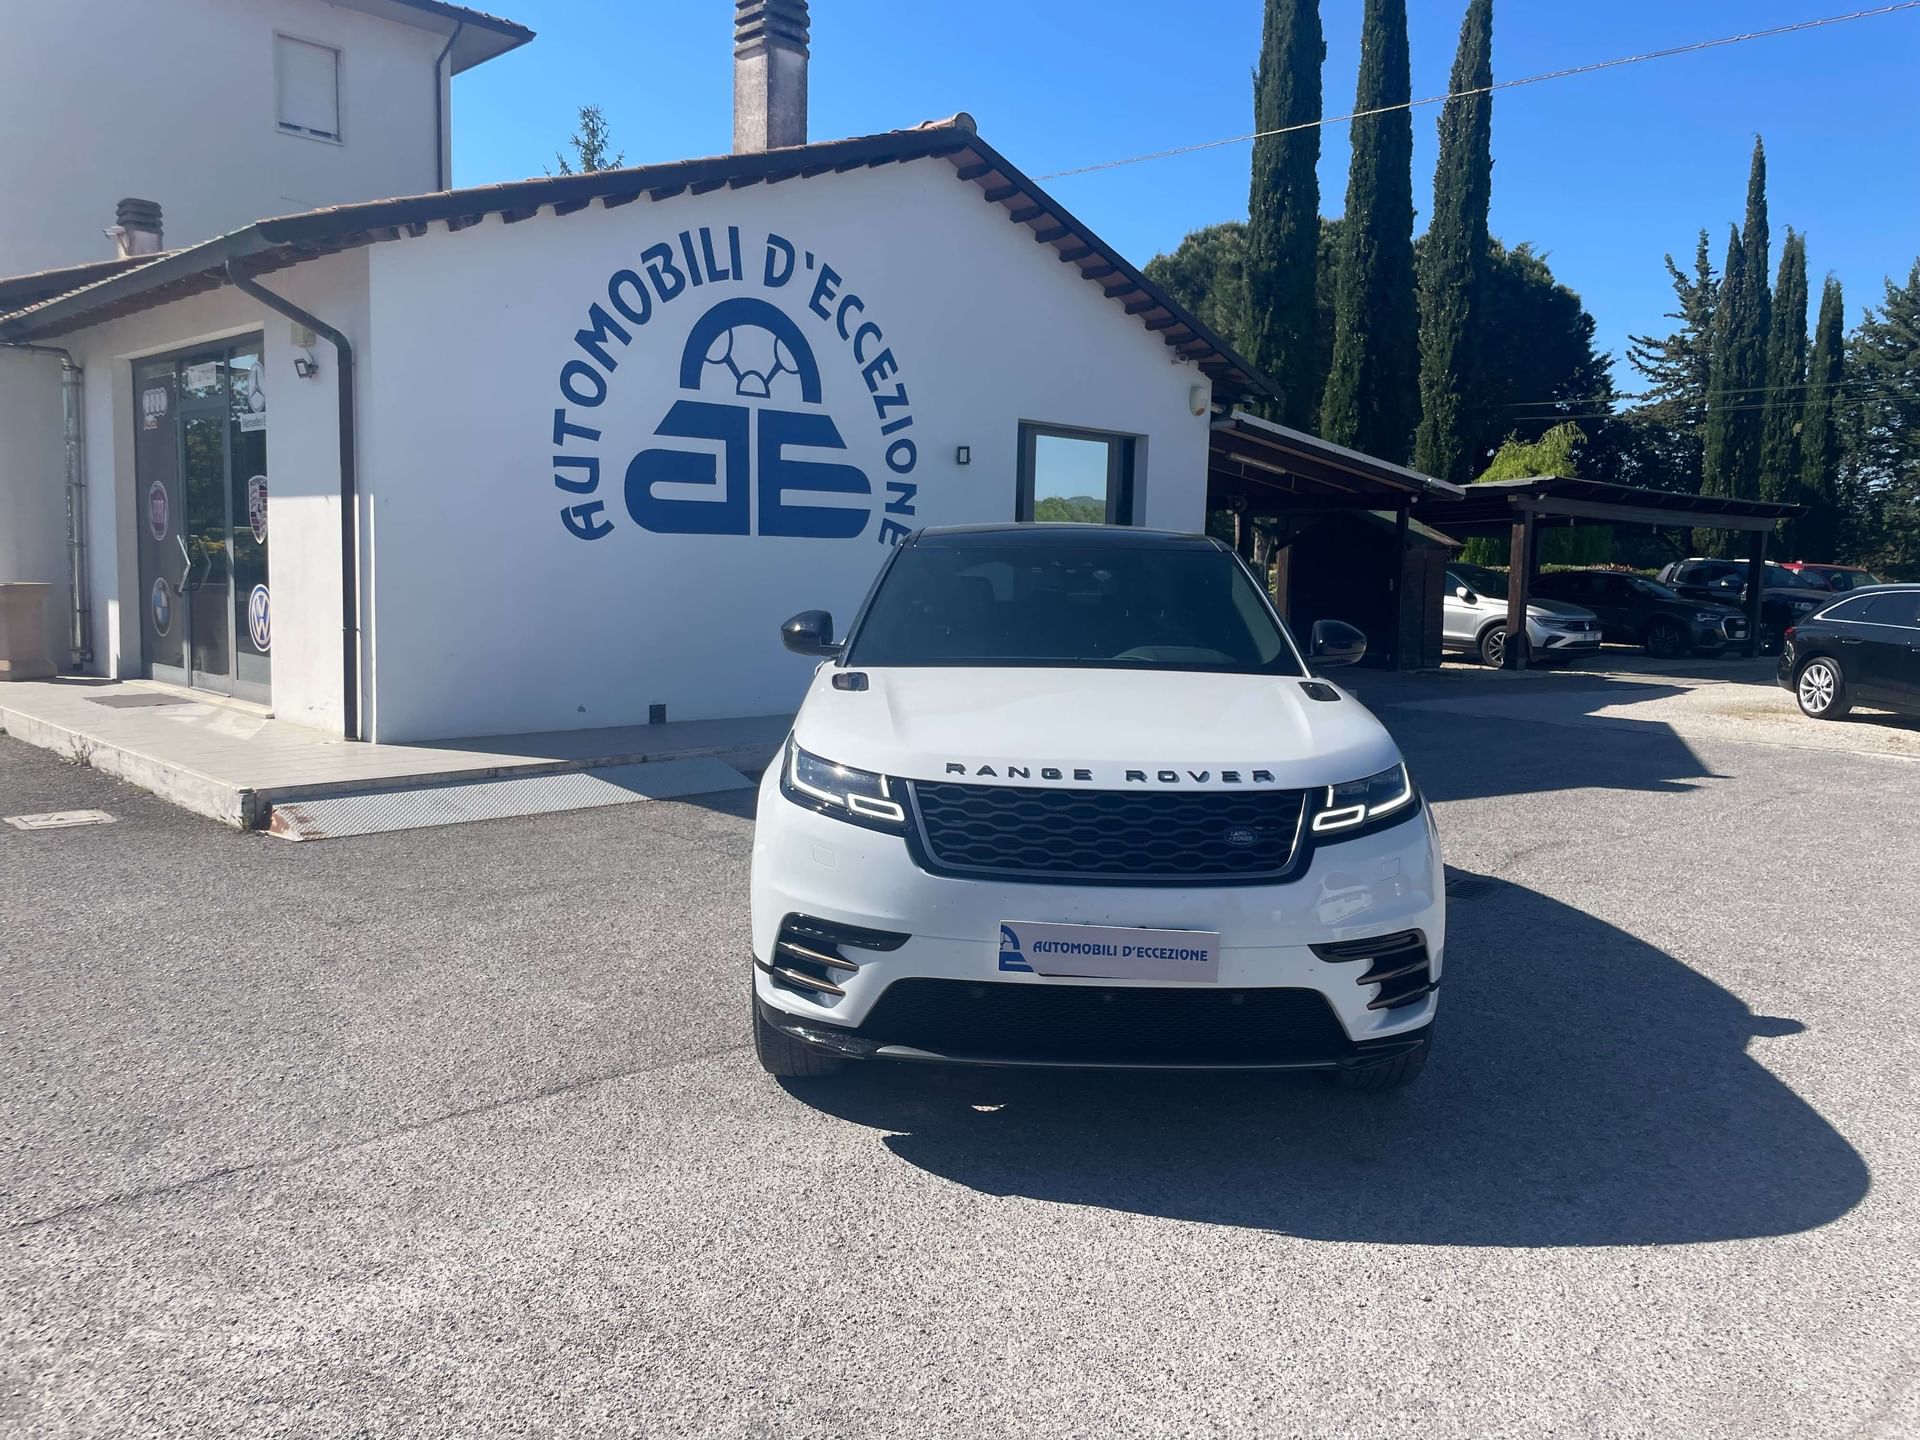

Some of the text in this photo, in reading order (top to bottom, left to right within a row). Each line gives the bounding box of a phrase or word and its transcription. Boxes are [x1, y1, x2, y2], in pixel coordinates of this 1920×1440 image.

[553, 226, 918, 547] AUTOMOBILI D'ECCEZIONE
[945, 762, 1276, 784] RANGE ROVER
[1033, 940, 1208, 962] AUTOMOBILI D'ECCEZIONE
